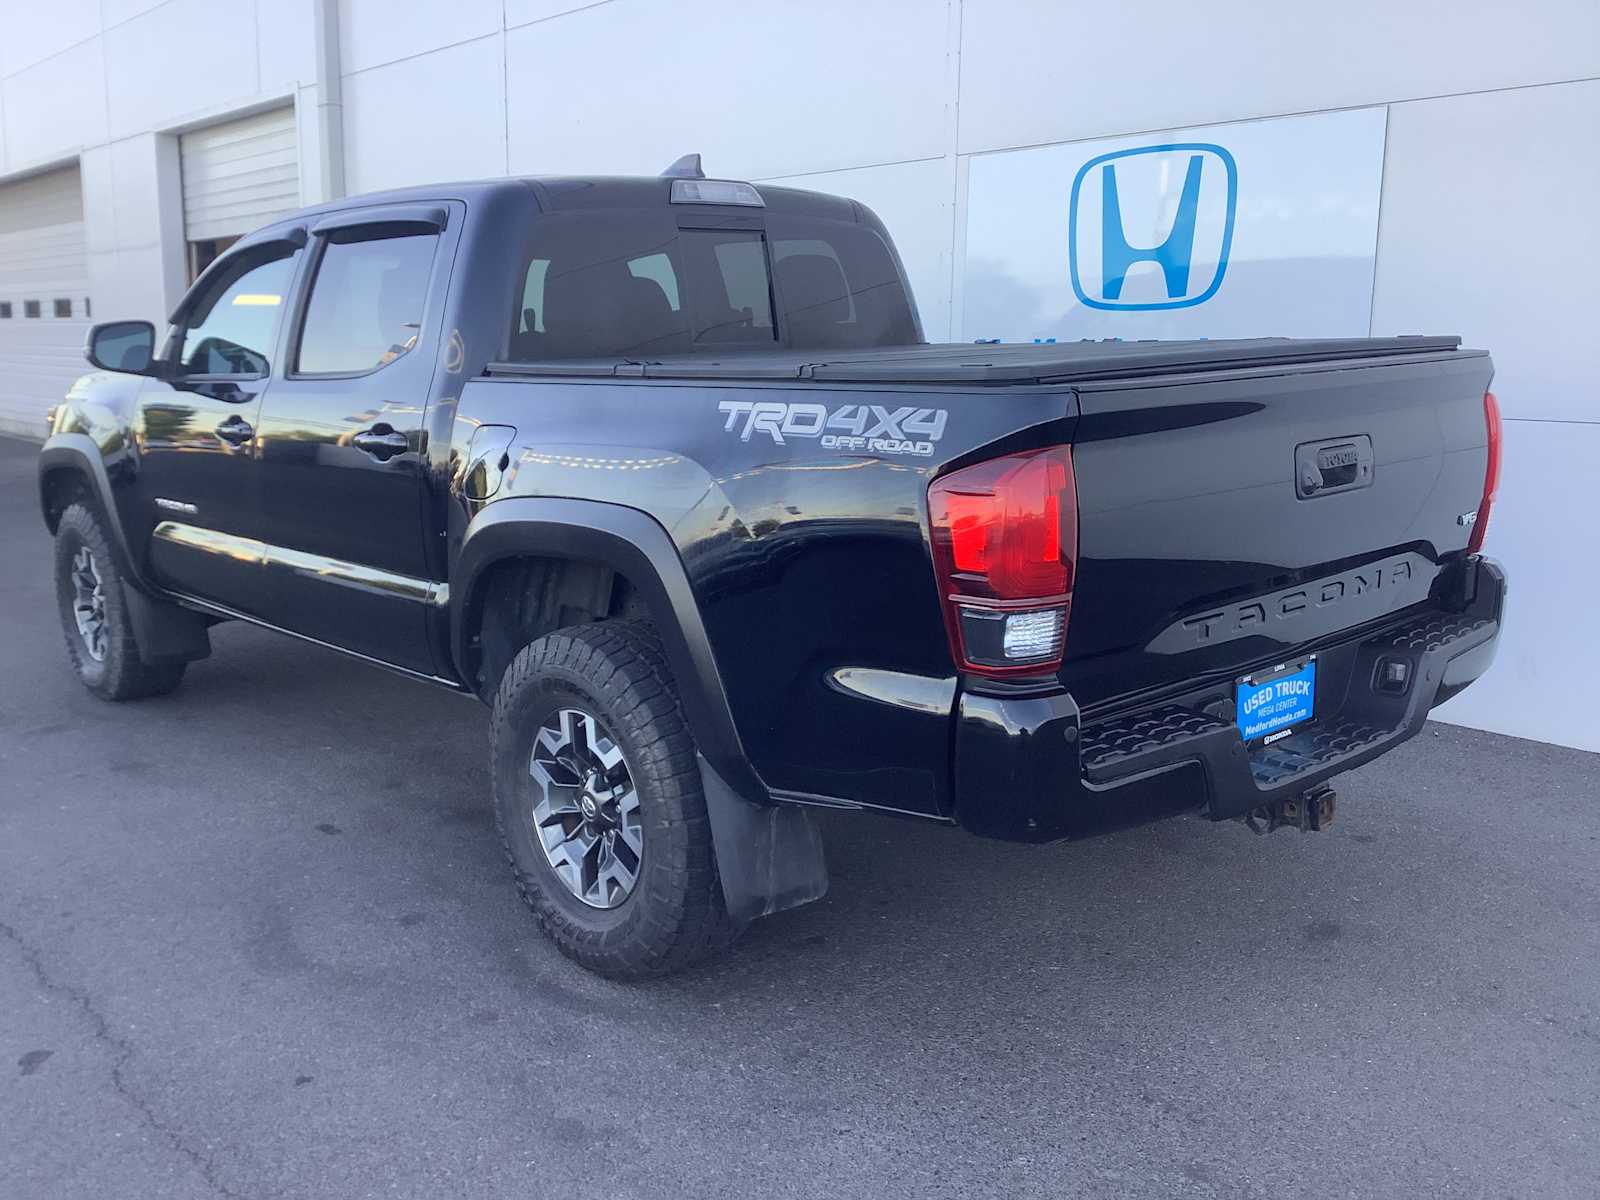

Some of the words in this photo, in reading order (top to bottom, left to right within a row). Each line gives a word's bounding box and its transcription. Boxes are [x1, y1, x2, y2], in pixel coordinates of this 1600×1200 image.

[717, 401, 828, 446] TRD
[820, 435, 866, 450] OFF
[867, 438, 936, 456] ROAD
[1183, 561, 1411, 641] TACOMA
[1243, 686, 1273, 714] USED
[1275, 680, 1311, 698] TRUCK
[1275, 697, 1298, 713] CENTER
[1245, 708, 1306, 736] MedfordHonda.com
